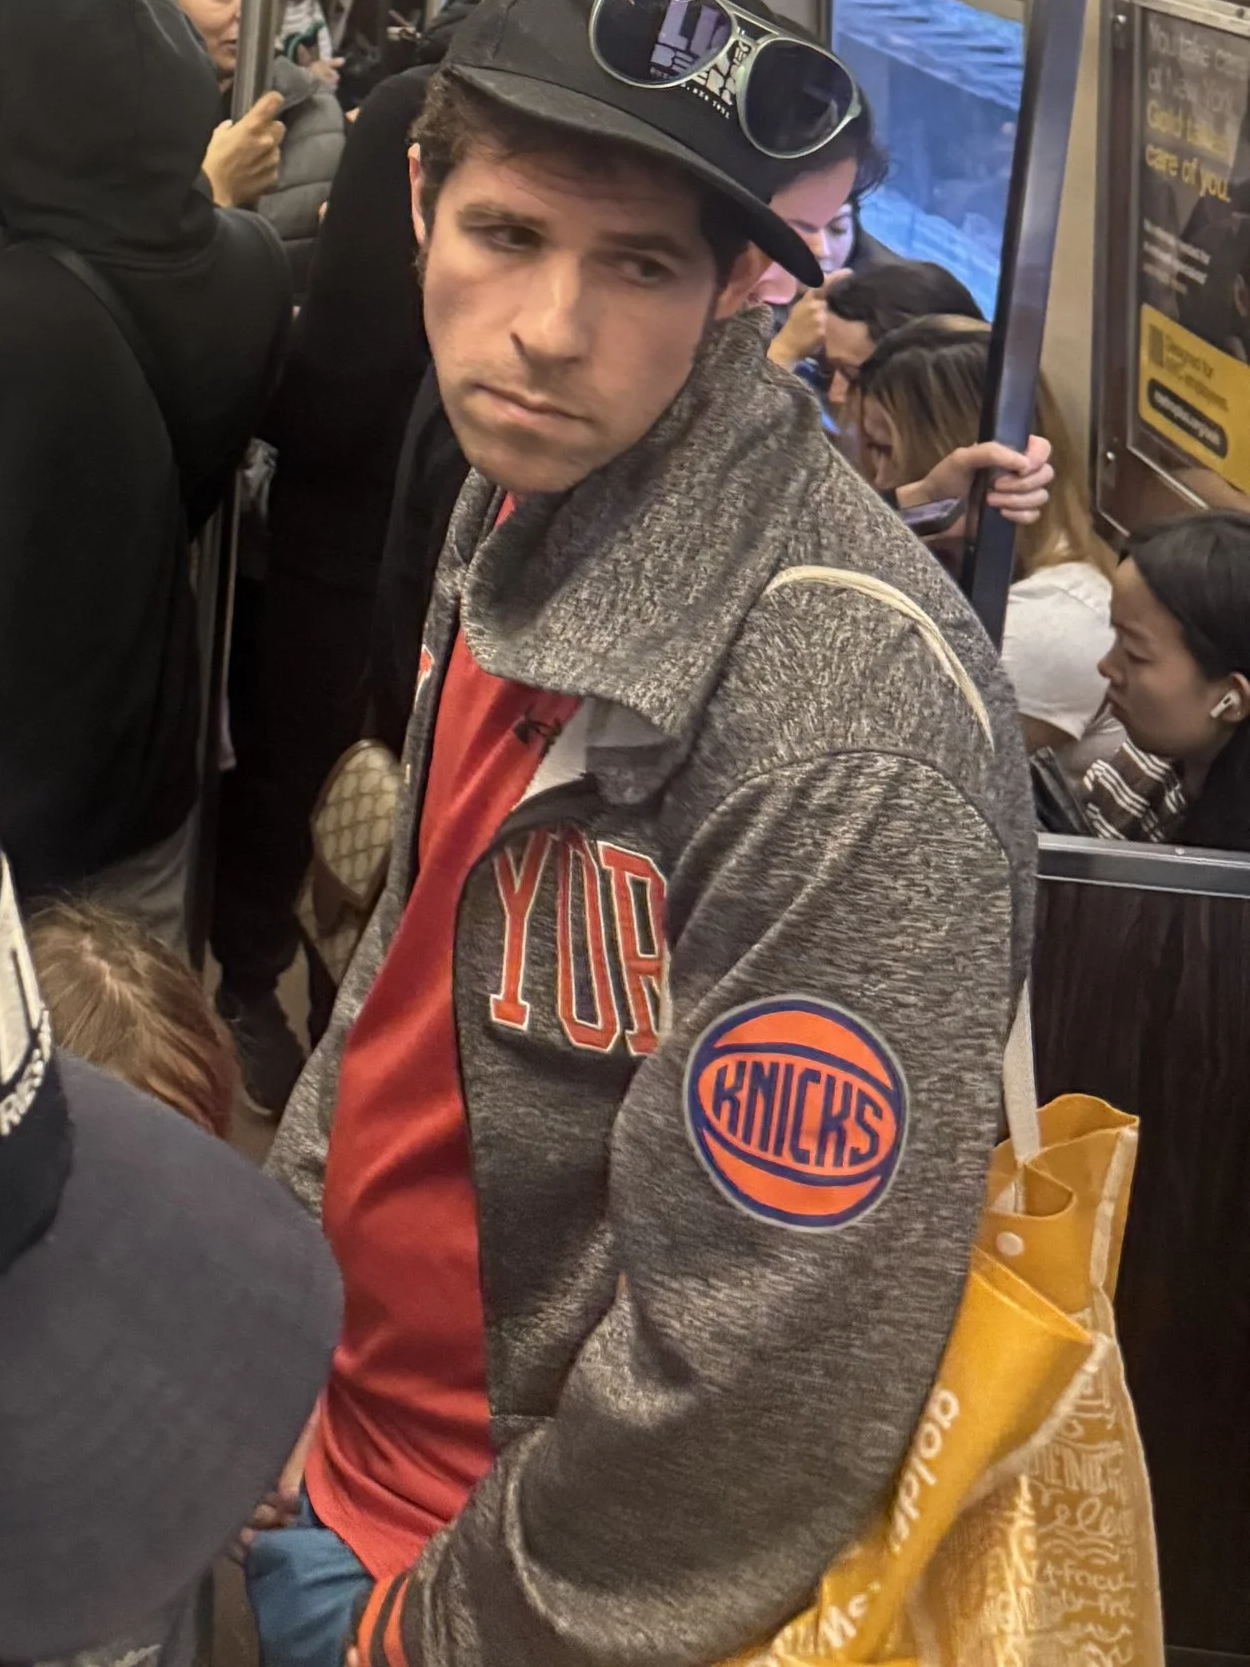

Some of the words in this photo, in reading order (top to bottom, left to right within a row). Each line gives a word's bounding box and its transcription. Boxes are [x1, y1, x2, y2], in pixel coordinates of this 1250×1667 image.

[1145, 143, 1179, 177] care
[1181, 157, 1199, 185] of
[1198, 167, 1231, 203] you.
[489, 827, 672, 1057] YOR
[711, 1059, 884, 1169] KNICKS
